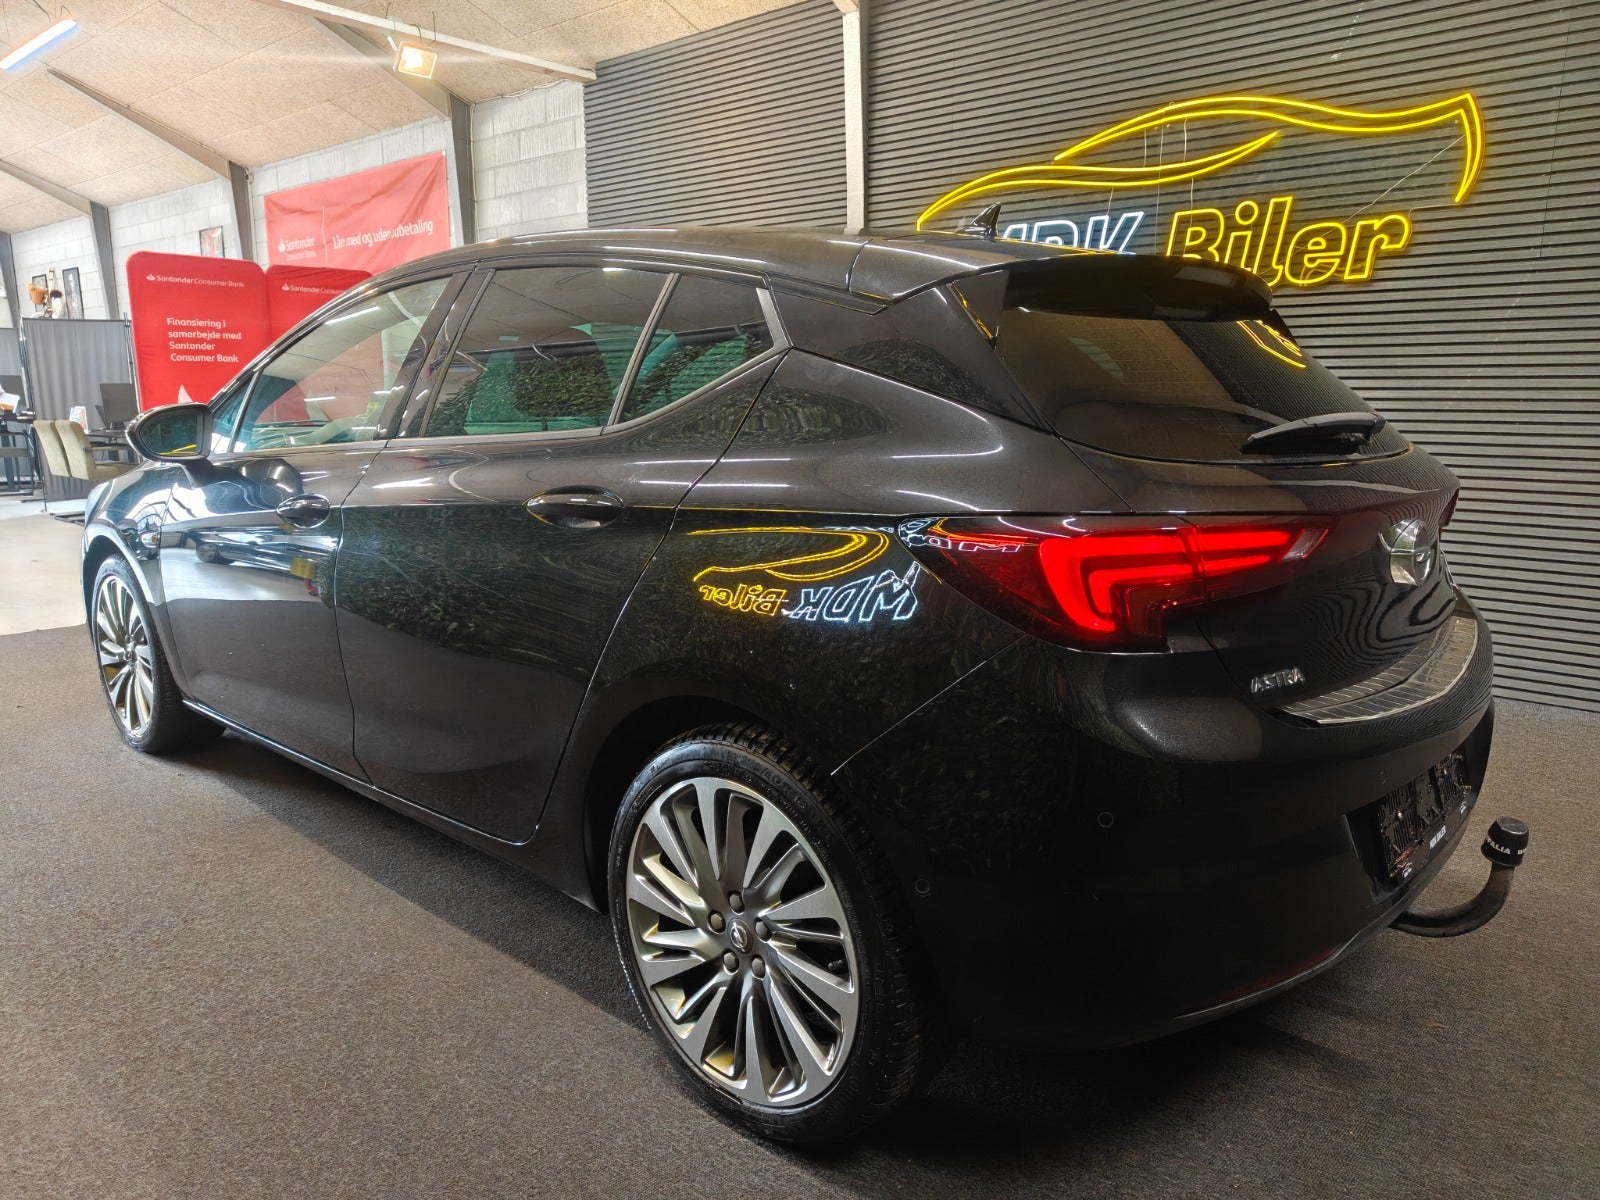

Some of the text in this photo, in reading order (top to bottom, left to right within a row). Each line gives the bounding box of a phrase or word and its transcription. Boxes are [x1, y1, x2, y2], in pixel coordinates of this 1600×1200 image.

[346, 232, 361, 246] med
[361, 233, 372, 247] og
[1165, 196, 1411, 286] Biler
[156, 274, 244, 288] Santander Consumer Bank
[290, 284, 320, 293] Santander
[166, 317, 226, 330] Finansiering i
[168, 330, 242, 341] samarbejde med
[169, 341, 216, 350] Santander
[170, 352, 239, 363] Consumer Bank
[1251, 667, 1305, 693] ASTRA
